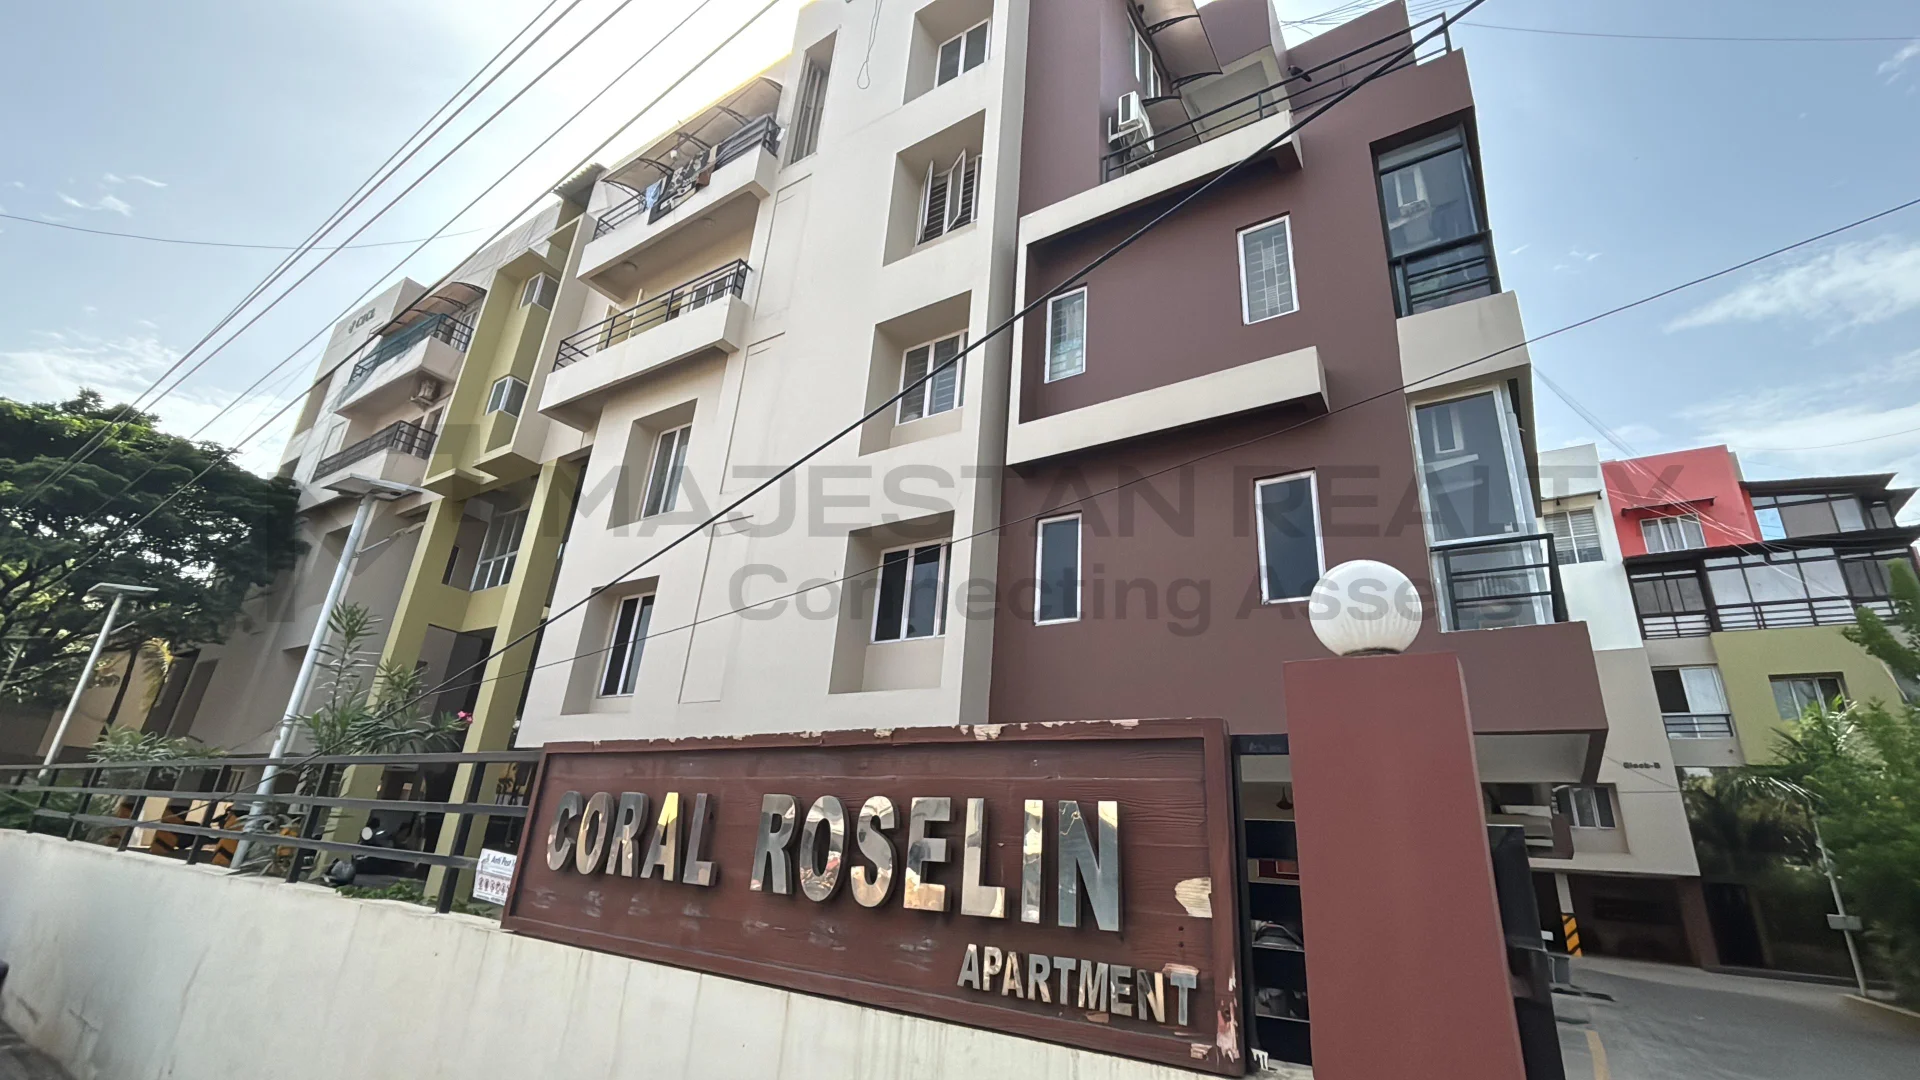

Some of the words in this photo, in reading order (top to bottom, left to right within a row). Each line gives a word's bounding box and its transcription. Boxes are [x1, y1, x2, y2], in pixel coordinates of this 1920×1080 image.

[547, 791, 717, 886] CORAL
[750, 794, 1120, 931] ROSELIN
[957, 943, 1197, 1026] APARTMENT
